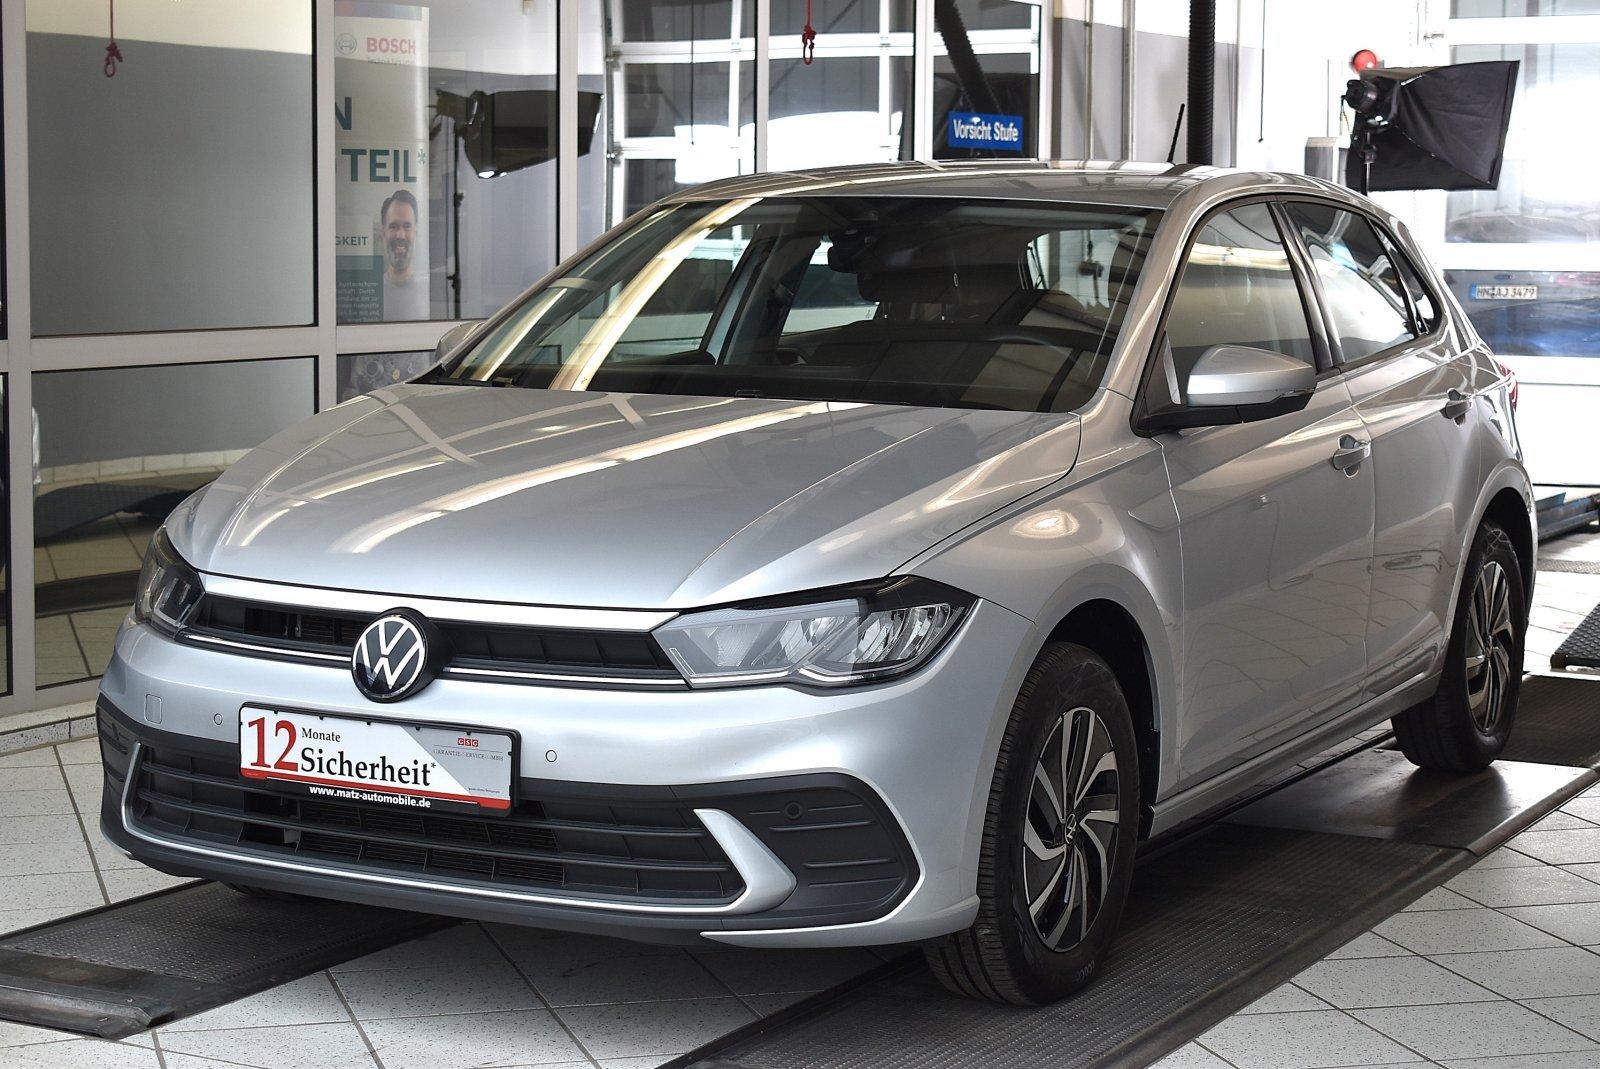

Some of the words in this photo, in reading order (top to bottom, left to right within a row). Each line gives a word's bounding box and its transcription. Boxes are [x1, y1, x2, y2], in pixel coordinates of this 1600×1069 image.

[366, 37, 416, 55] BOSCH
[953, 119, 992, 140] Vorsicht
[993, 121, 1019, 142] Stufe
[248, 716, 299, 772] 12
[301, 727, 341, 742] Monate
[458, 737, 479, 747] GSG
[309, 785, 431, 808] www.matz-automobile.de
